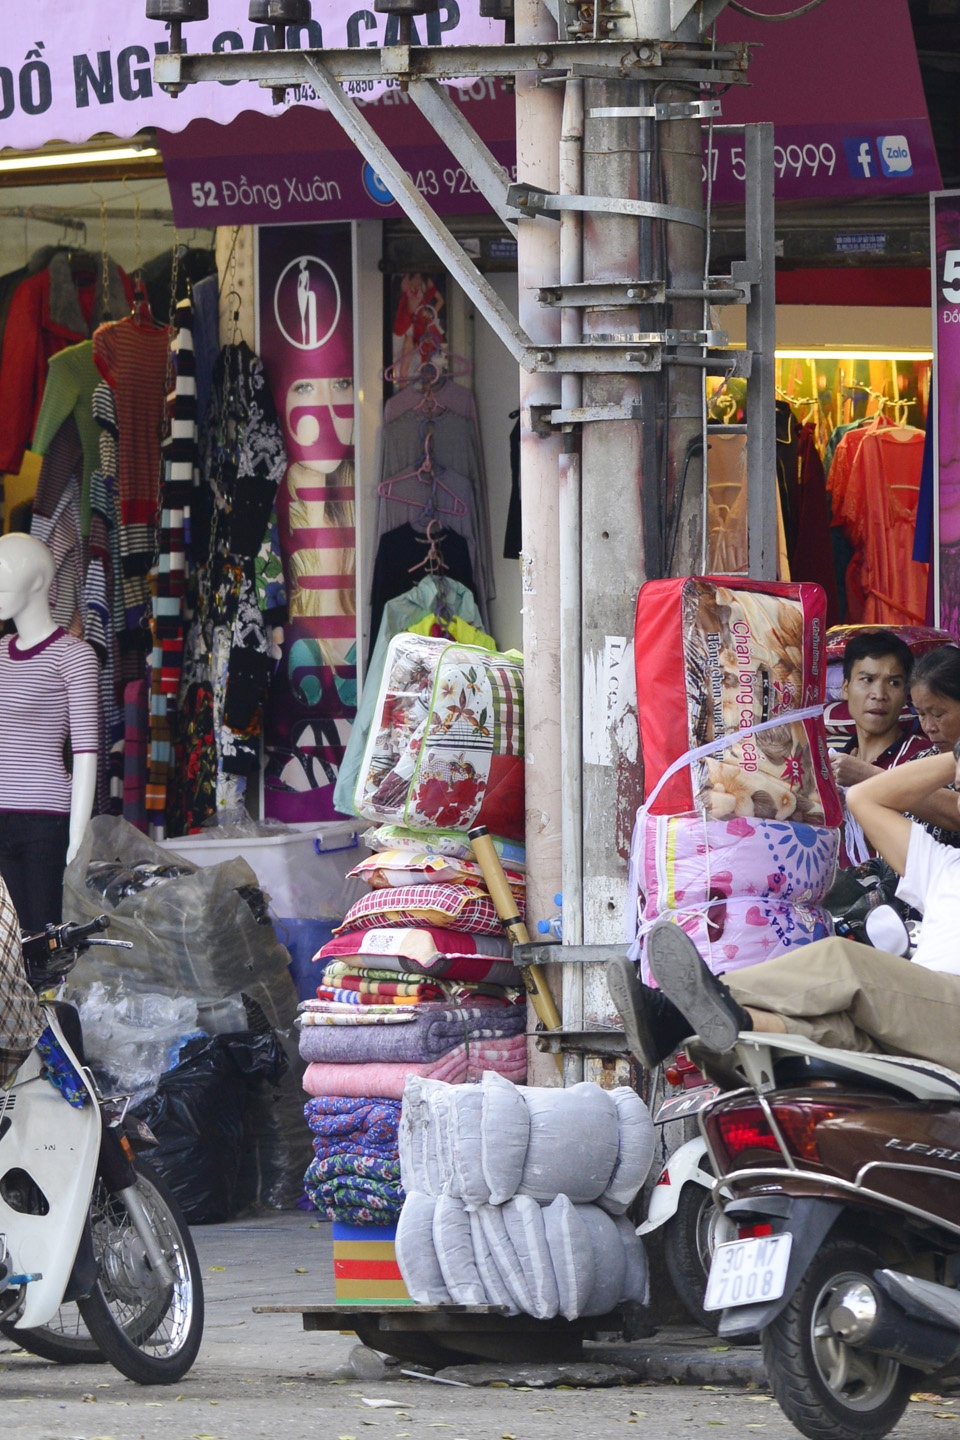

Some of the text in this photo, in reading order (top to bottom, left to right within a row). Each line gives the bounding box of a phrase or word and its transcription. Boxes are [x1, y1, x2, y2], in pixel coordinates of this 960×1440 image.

[885, 146, 908, 159] Zalo
[191, 181, 219, 207] 52
[222, 175, 282, 211] Đồng
[287, 176, 342, 202] Xuân
[732, 621, 754, 665] Chăn
[791, 760, 801, 778] OK
[717, 1269, 774, 1305] 7008
